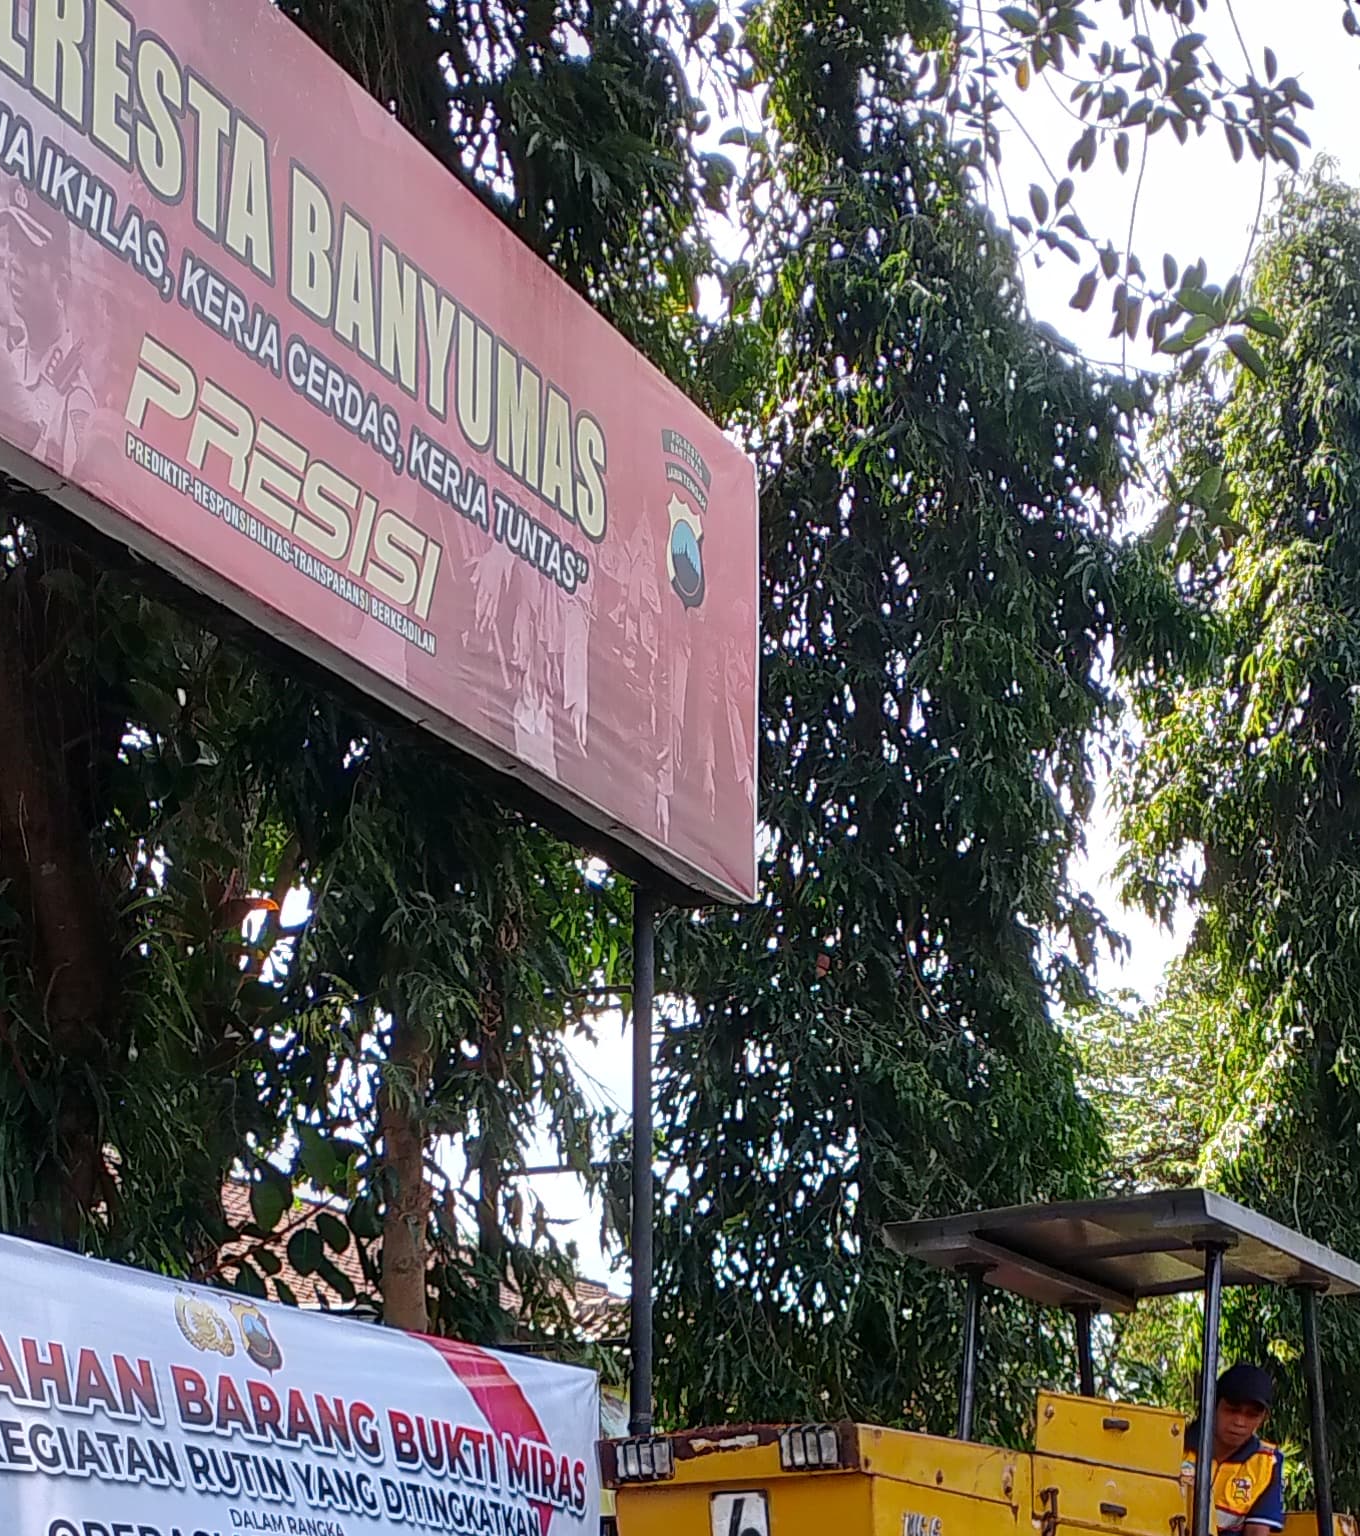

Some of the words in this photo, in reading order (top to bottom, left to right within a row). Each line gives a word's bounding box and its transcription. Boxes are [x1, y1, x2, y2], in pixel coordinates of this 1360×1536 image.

[39, 147, 172, 296] IKHLAS,
[180, 255, 280, 371] KERJA
[287, 341, 402, 468] CERDAS,
[409, 431, 488, 528] KERJA
[289, 162, 607, 540] BANYUMAS
[125, 332, 444, 621] PRESISI
[371, 598, 436, 654] BERKEADILAN
[170, 1364, 379, 1460] BARANG
[387, 1408, 498, 1485] BUKTI
[504, 1437, 586, 1511] MIRAS
[185, 1444, 293, 1499] RUTIN
[291, 1461, 378, 1511] YANG
[229, 1508, 285, 1534] DALAM
